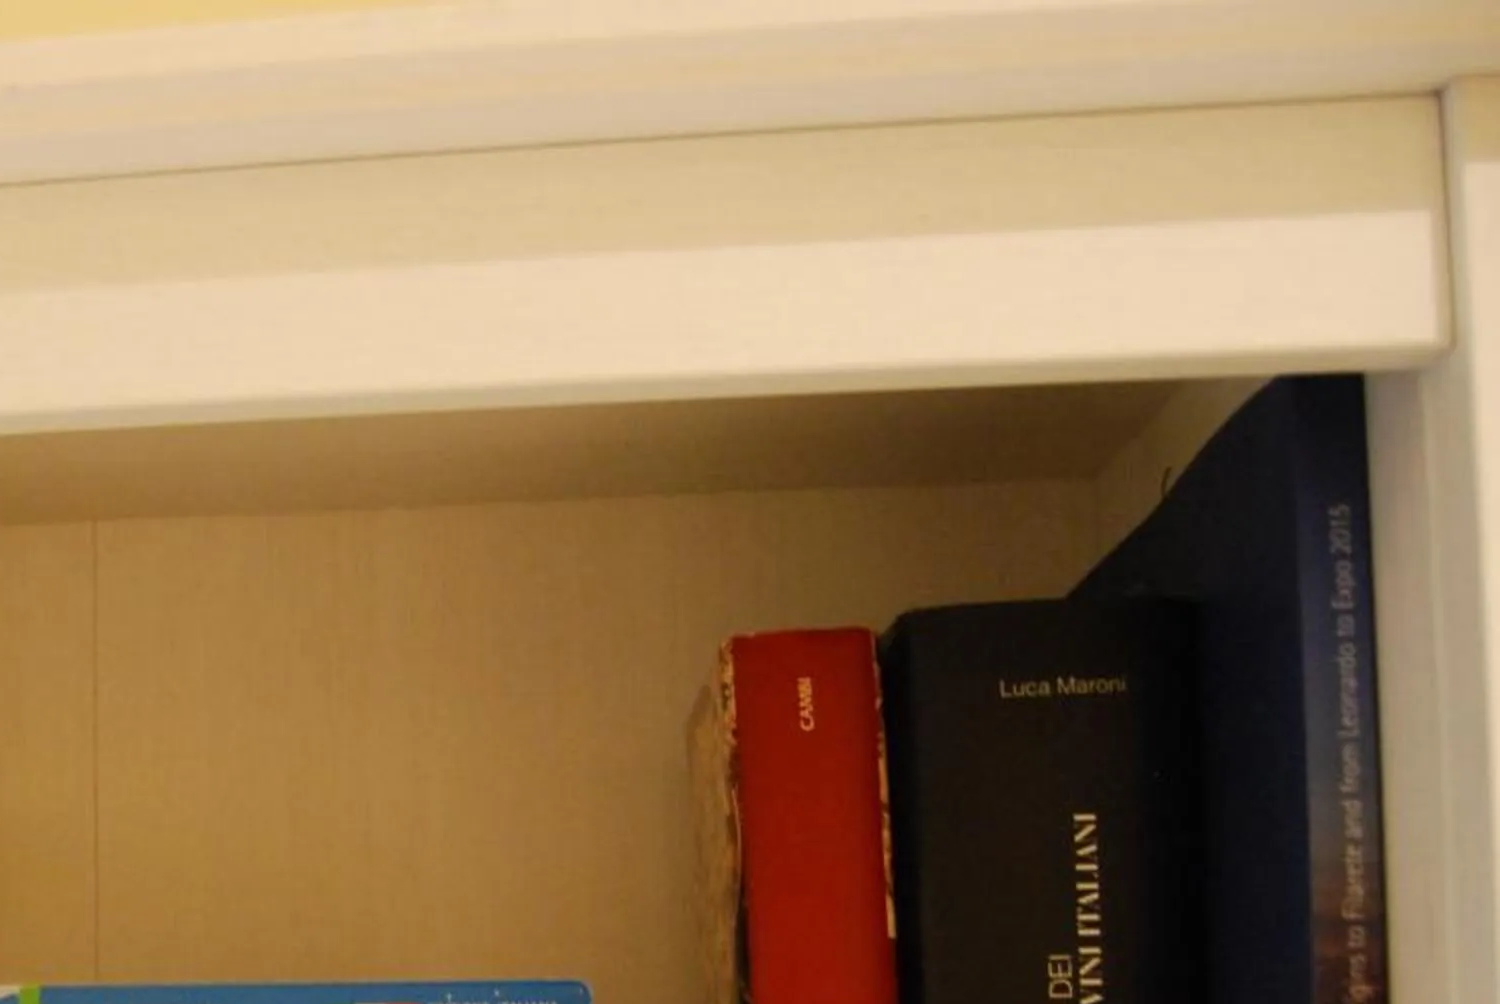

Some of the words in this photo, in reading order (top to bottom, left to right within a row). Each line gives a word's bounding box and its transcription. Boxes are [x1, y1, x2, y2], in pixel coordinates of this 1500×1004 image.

[1328, 503, 1353, 554] 2015
[798, 676, 816, 732] CAMBI
[999, 679, 1051, 699] Luca
[1056, 674, 1128, 696] Maroni
[1072, 812, 1103, 937] ITALIANI
[1047, 954, 1074, 1000] DEI
